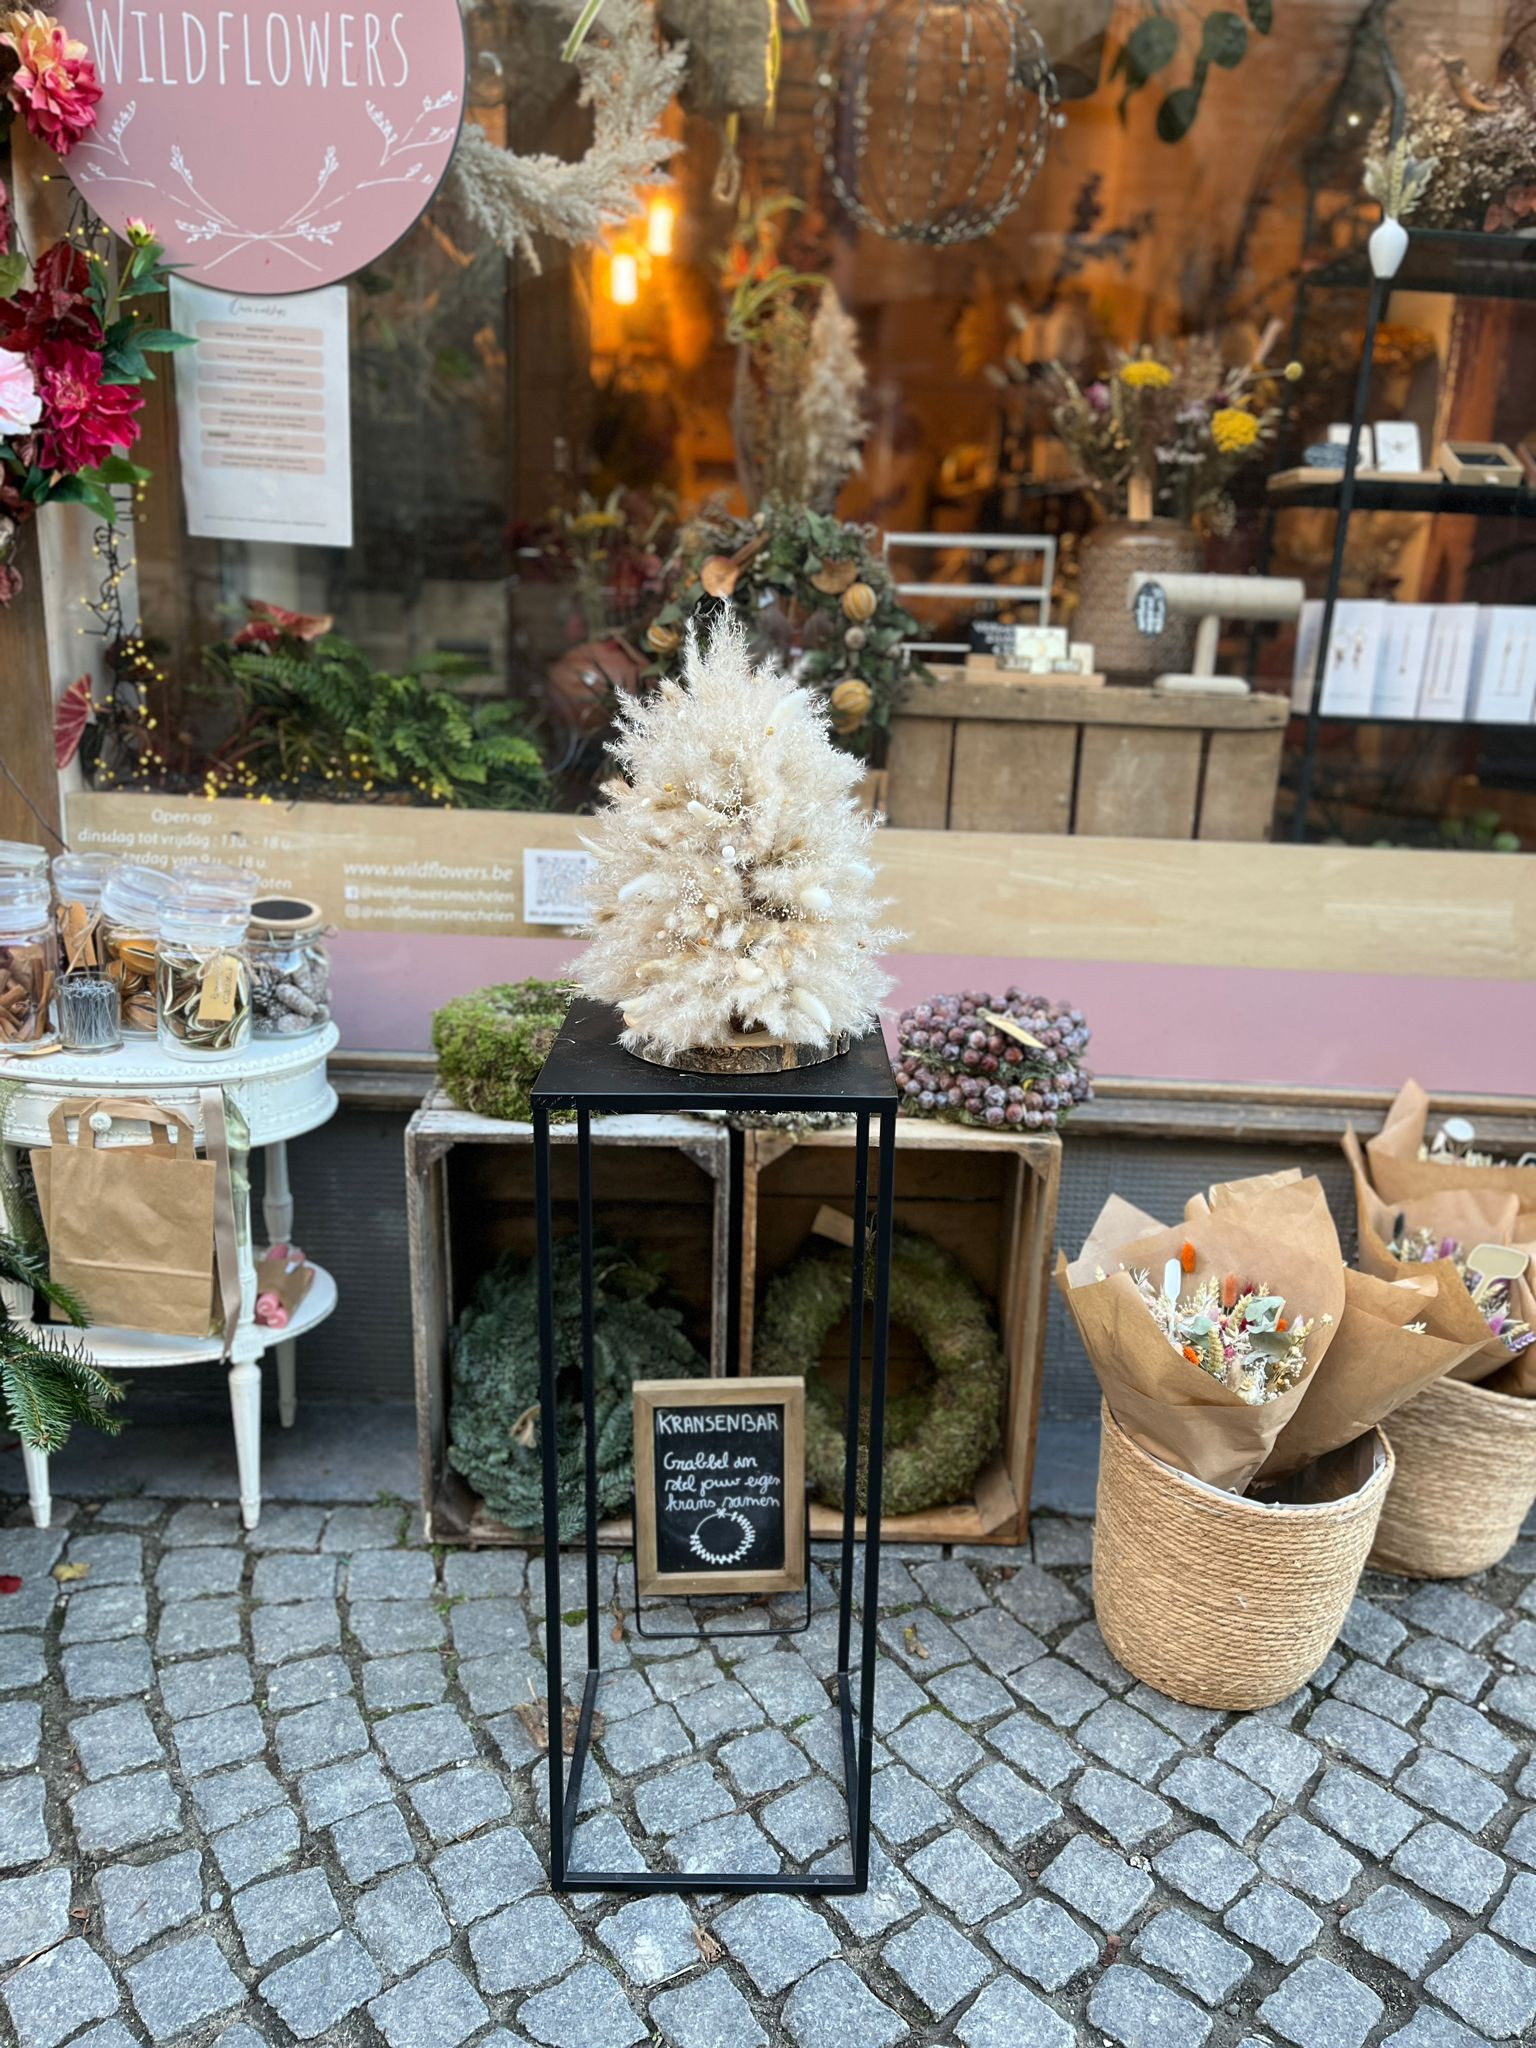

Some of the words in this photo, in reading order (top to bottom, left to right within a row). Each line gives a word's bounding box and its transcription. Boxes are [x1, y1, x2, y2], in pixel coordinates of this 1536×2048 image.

[86, 0, 409, 87] WILDFLOWERS
[151, 808, 191, 825] Open
[192, 812, 213, 826] op
[77, 828, 135, 845] dinsdag
[138, 830, 158, 845] tot
[160, 830, 209, 849] vrijdag
[343, 861, 513, 882] www.wildflowers.be
[656, 1411, 780, 1435] KRANSENBAR
[663, 1451, 729, 1471] Grabbel
[664, 1474, 697, 1492] stel
[700, 1477, 740, 1497] jouw
[744, 1474, 781, 1495] eigen
[665, 1493, 716, 1512] krans
[722, 1495, 781, 1510] samen
